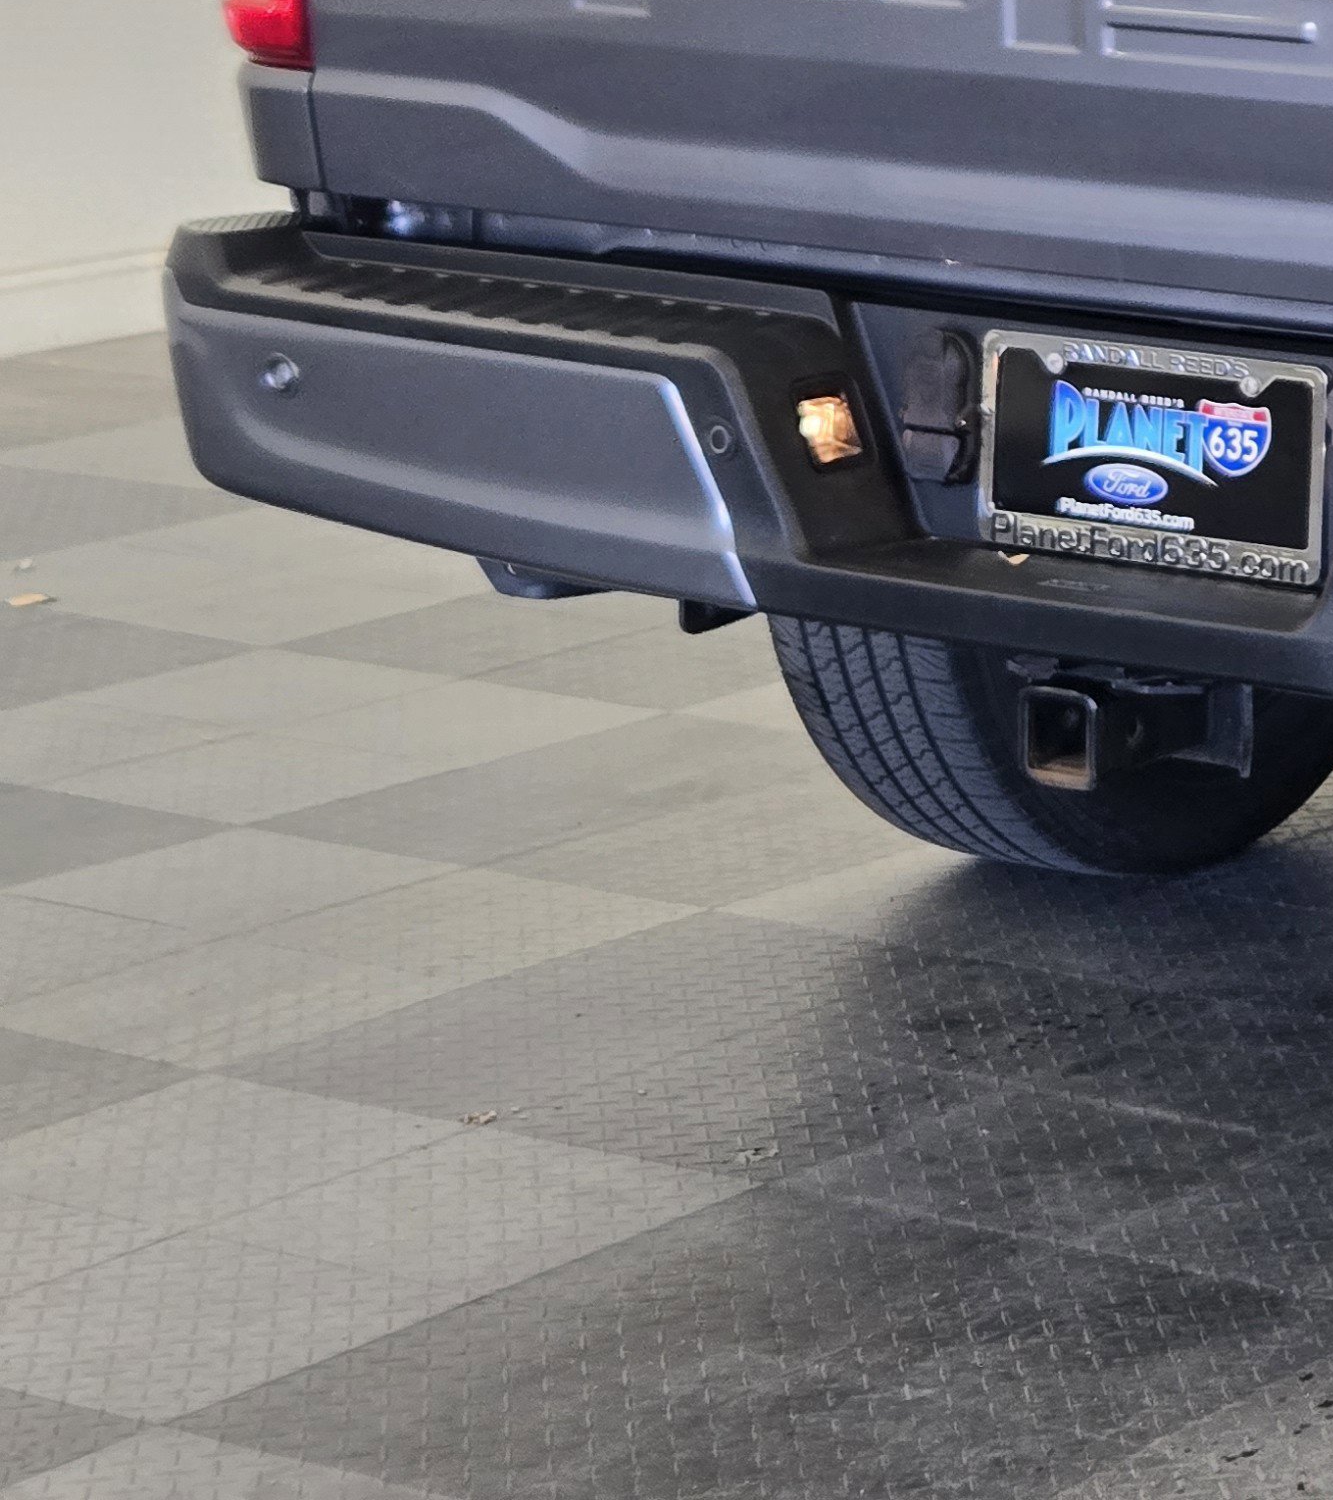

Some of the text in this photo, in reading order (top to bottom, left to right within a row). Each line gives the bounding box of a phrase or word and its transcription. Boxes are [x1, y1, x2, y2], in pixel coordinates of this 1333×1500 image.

[1063, 341, 1166, 369] RANDALL
[1050, 380, 1209, 475] PLANET
[1208, 426, 1259, 462] 635
[1102, 471, 1151, 499] Ford
[1056, 497, 1195, 533] PlanetFord635.com
[990, 511, 1308, 584] PlanetFord635.com
